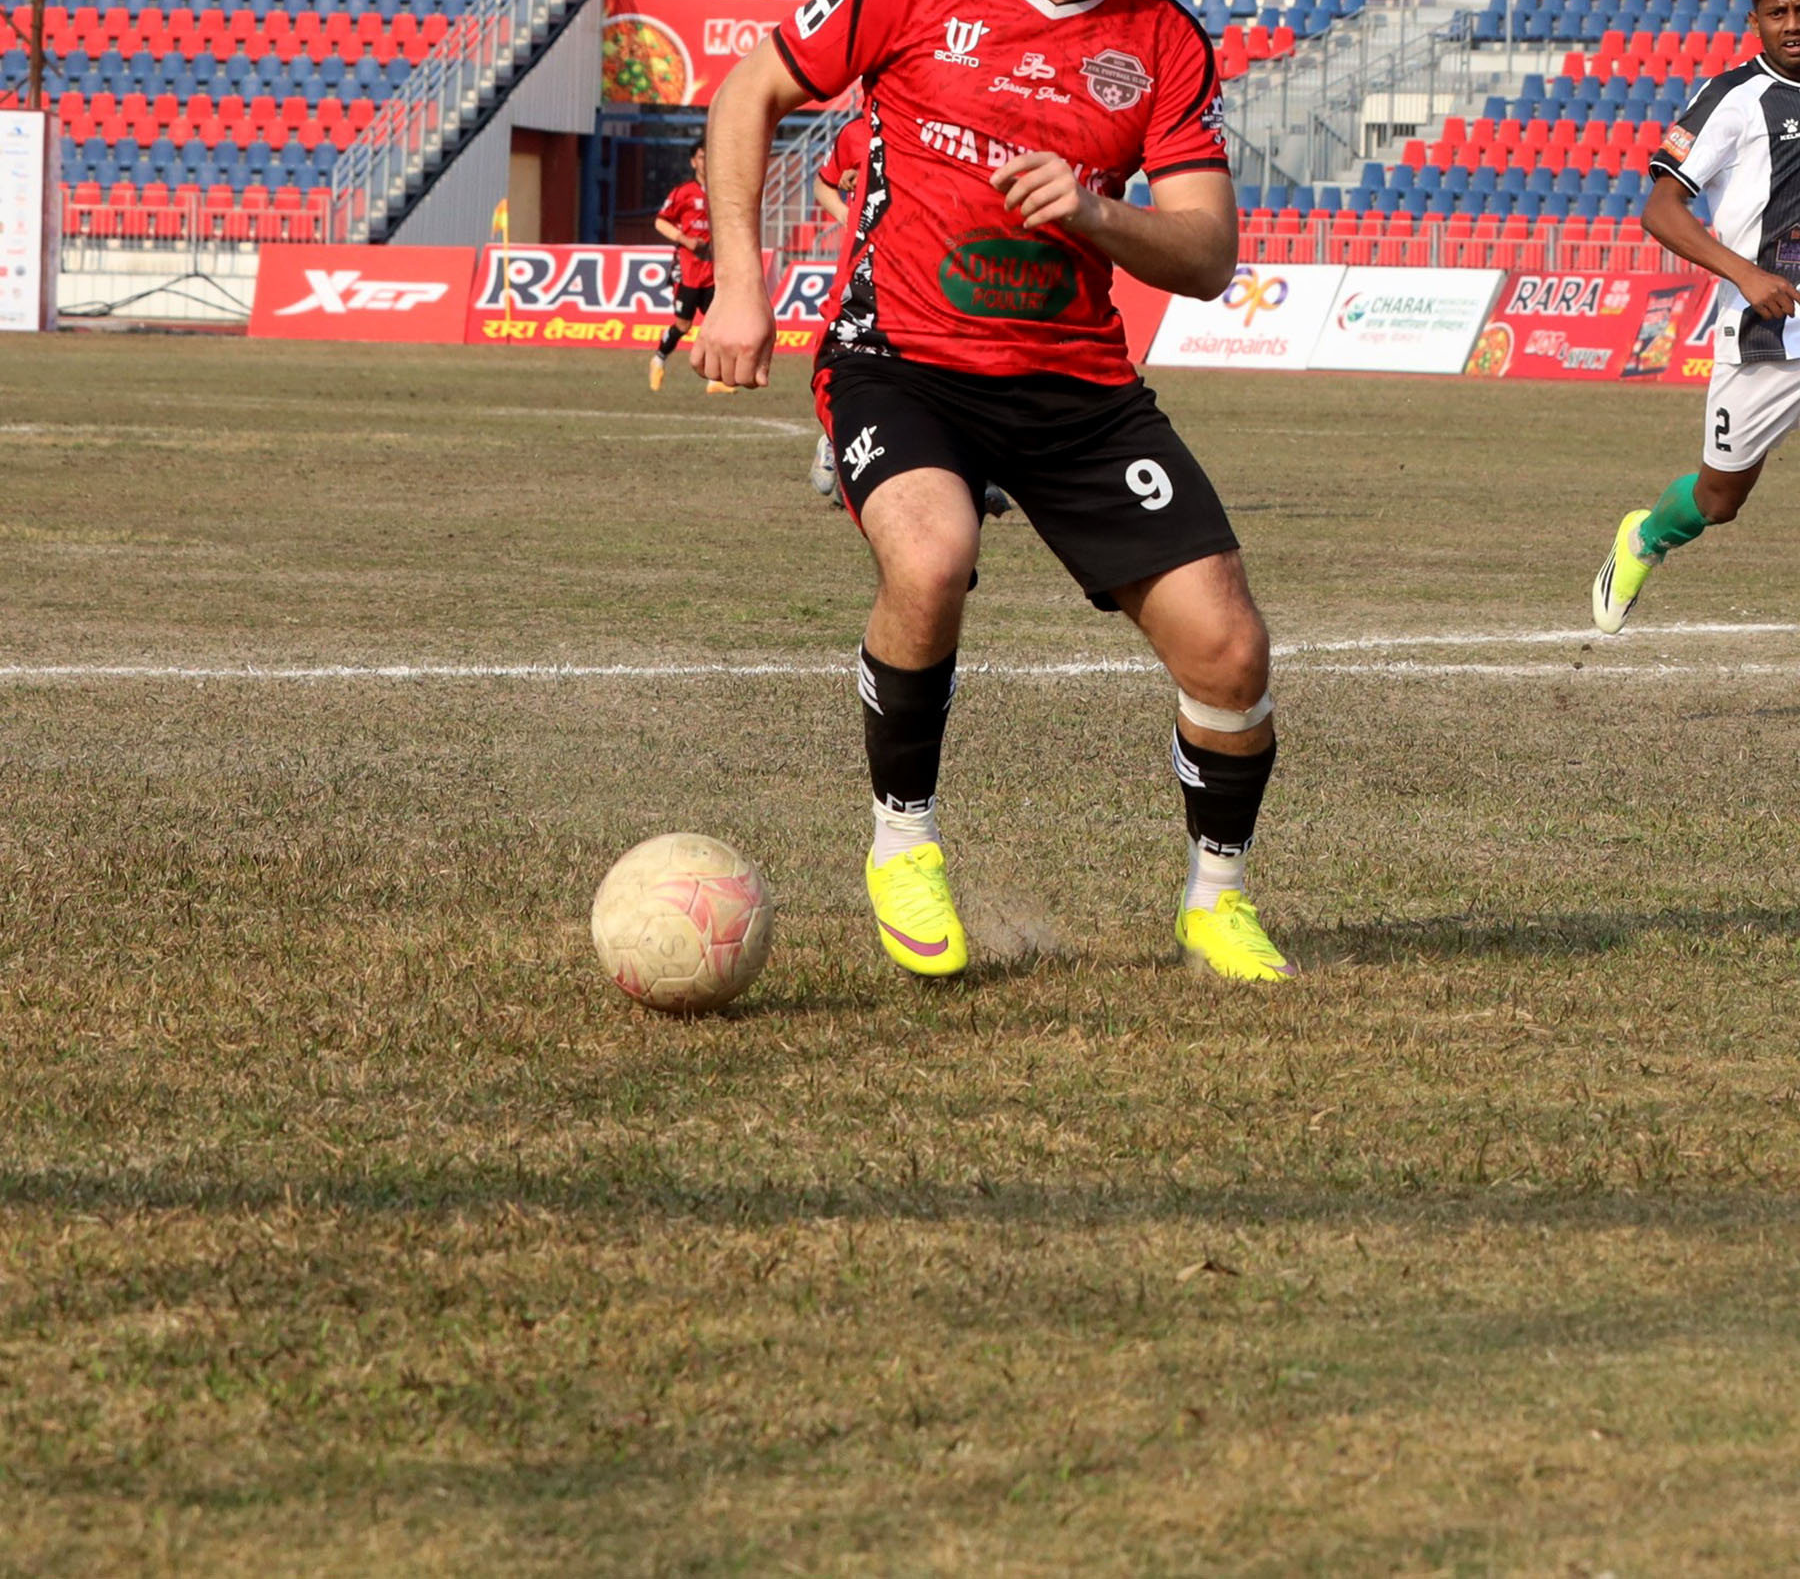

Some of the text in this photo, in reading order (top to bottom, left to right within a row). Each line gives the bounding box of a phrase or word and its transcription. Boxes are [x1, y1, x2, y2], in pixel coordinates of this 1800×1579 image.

[934, 49, 980, 68] SCATO
[988, 76, 1034, 99] Jersey
[274, 269, 449, 315] XTEP
[475, 250, 675, 312] RAR
[1504, 276, 1604, 316] RARA
[1371, 297, 1433, 314] CHARAK
[1180, 332, 1289, 359] asianpaints
[1714, 407, 1732, 453] 2
[1125, 459, 1173, 511] 9
